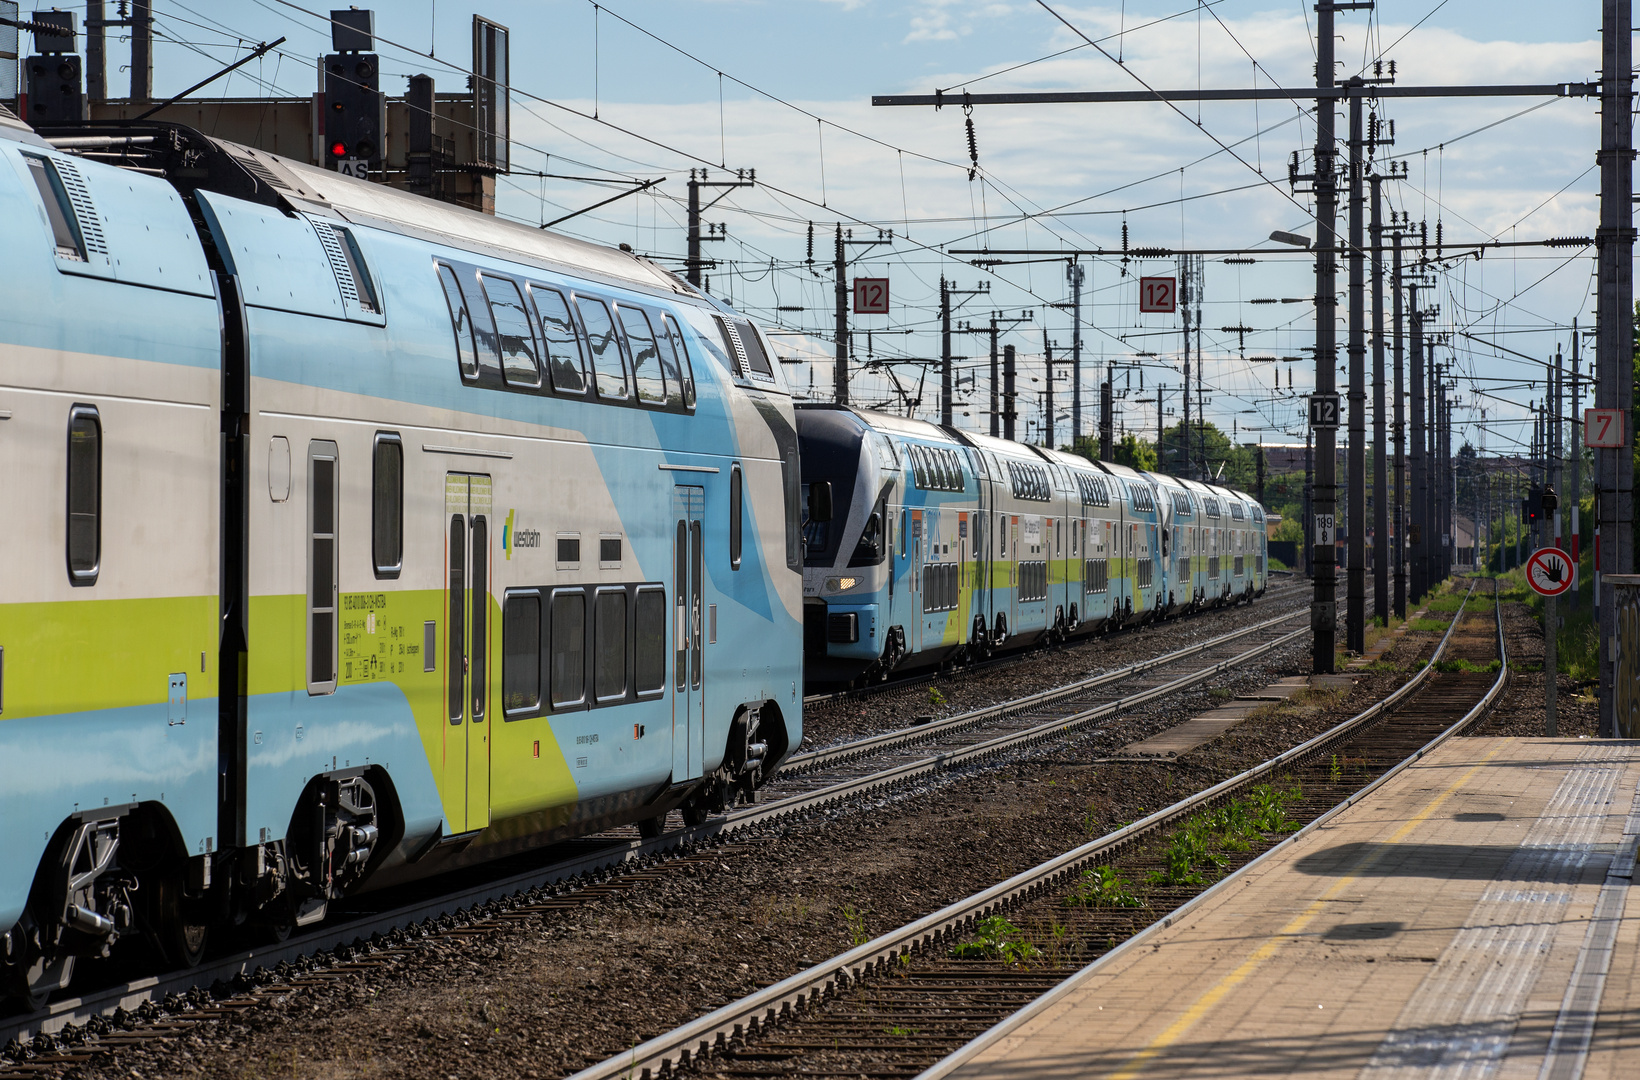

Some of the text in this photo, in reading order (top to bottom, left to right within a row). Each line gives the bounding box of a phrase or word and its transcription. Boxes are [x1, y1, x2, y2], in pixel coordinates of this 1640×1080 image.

[342, 163, 367, 180] AS
[860, 285, 883, 307] 12
[1146, 283, 1169, 306] 12
[1313, 401, 1334, 421] 12
[1597, 415, 1612, 440] 7
[1316, 517, 1333, 528] 189
[514, 528, 541, 547] westbahn
[1321, 530, 1328, 542] 8
